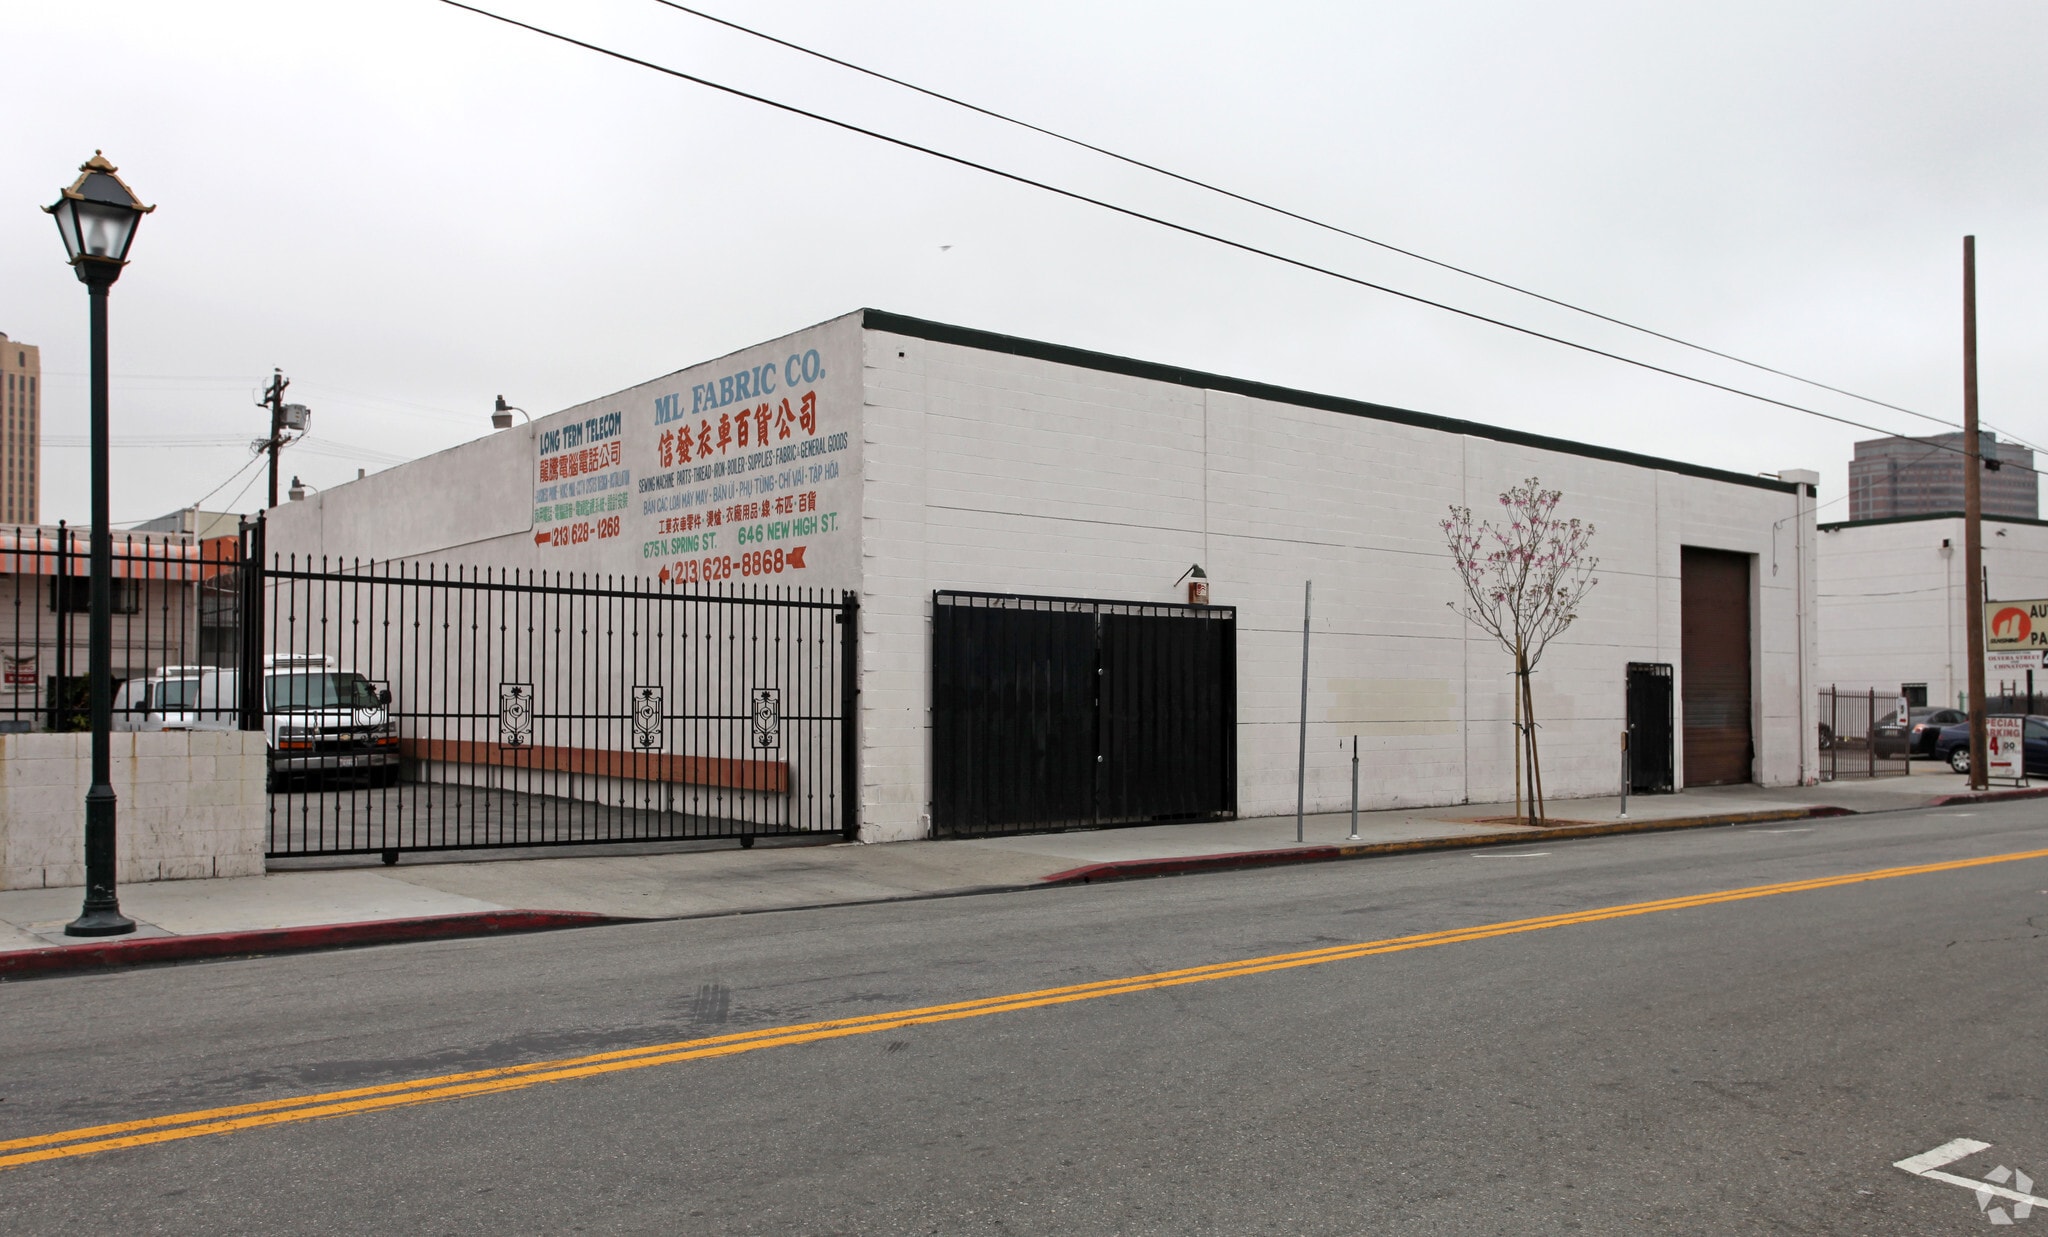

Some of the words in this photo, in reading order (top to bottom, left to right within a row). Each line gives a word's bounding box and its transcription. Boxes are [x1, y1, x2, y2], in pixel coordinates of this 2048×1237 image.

[654, 393, 684, 426] ML
[692, 363, 776, 414] FABRIC
[785, 349, 826, 387] CO.
[540, 429, 560, 456] LONG
[563, 422, 583, 449] TERM
[586, 411, 621, 443] TELECOM
[658, 390, 817, 468] 信發衣車百貨公司
[677, 469, 692, 485] PARTS
[694, 464, 711, 482] THREAD
[727, 456, 745, 475] BOILER
[748, 450, 773, 470] SUPPLIES
[776, 444, 796, 464] FABRIC
[800, 437, 826, 458] GENERAL
[828, 431, 848, 452] GOODS
[552, 525, 570, 547] (213)
[571, 515, 620, 544] 628-1268
[644, 541, 660, 558] 675
[671, 535, 700, 555] SPRING
[702, 532, 717, 551] ST.
[738, 524, 763, 545] 646
[767, 520, 790, 541] NEW
[793, 516, 817, 537] HIGH
[821, 512, 839, 532] ST.
[671, 559, 700, 584] (213)
[703, 548, 784, 581] 628-8868
[2030, 604, 2048, 618] AU
[1989, 736, 1999, 755] 4
